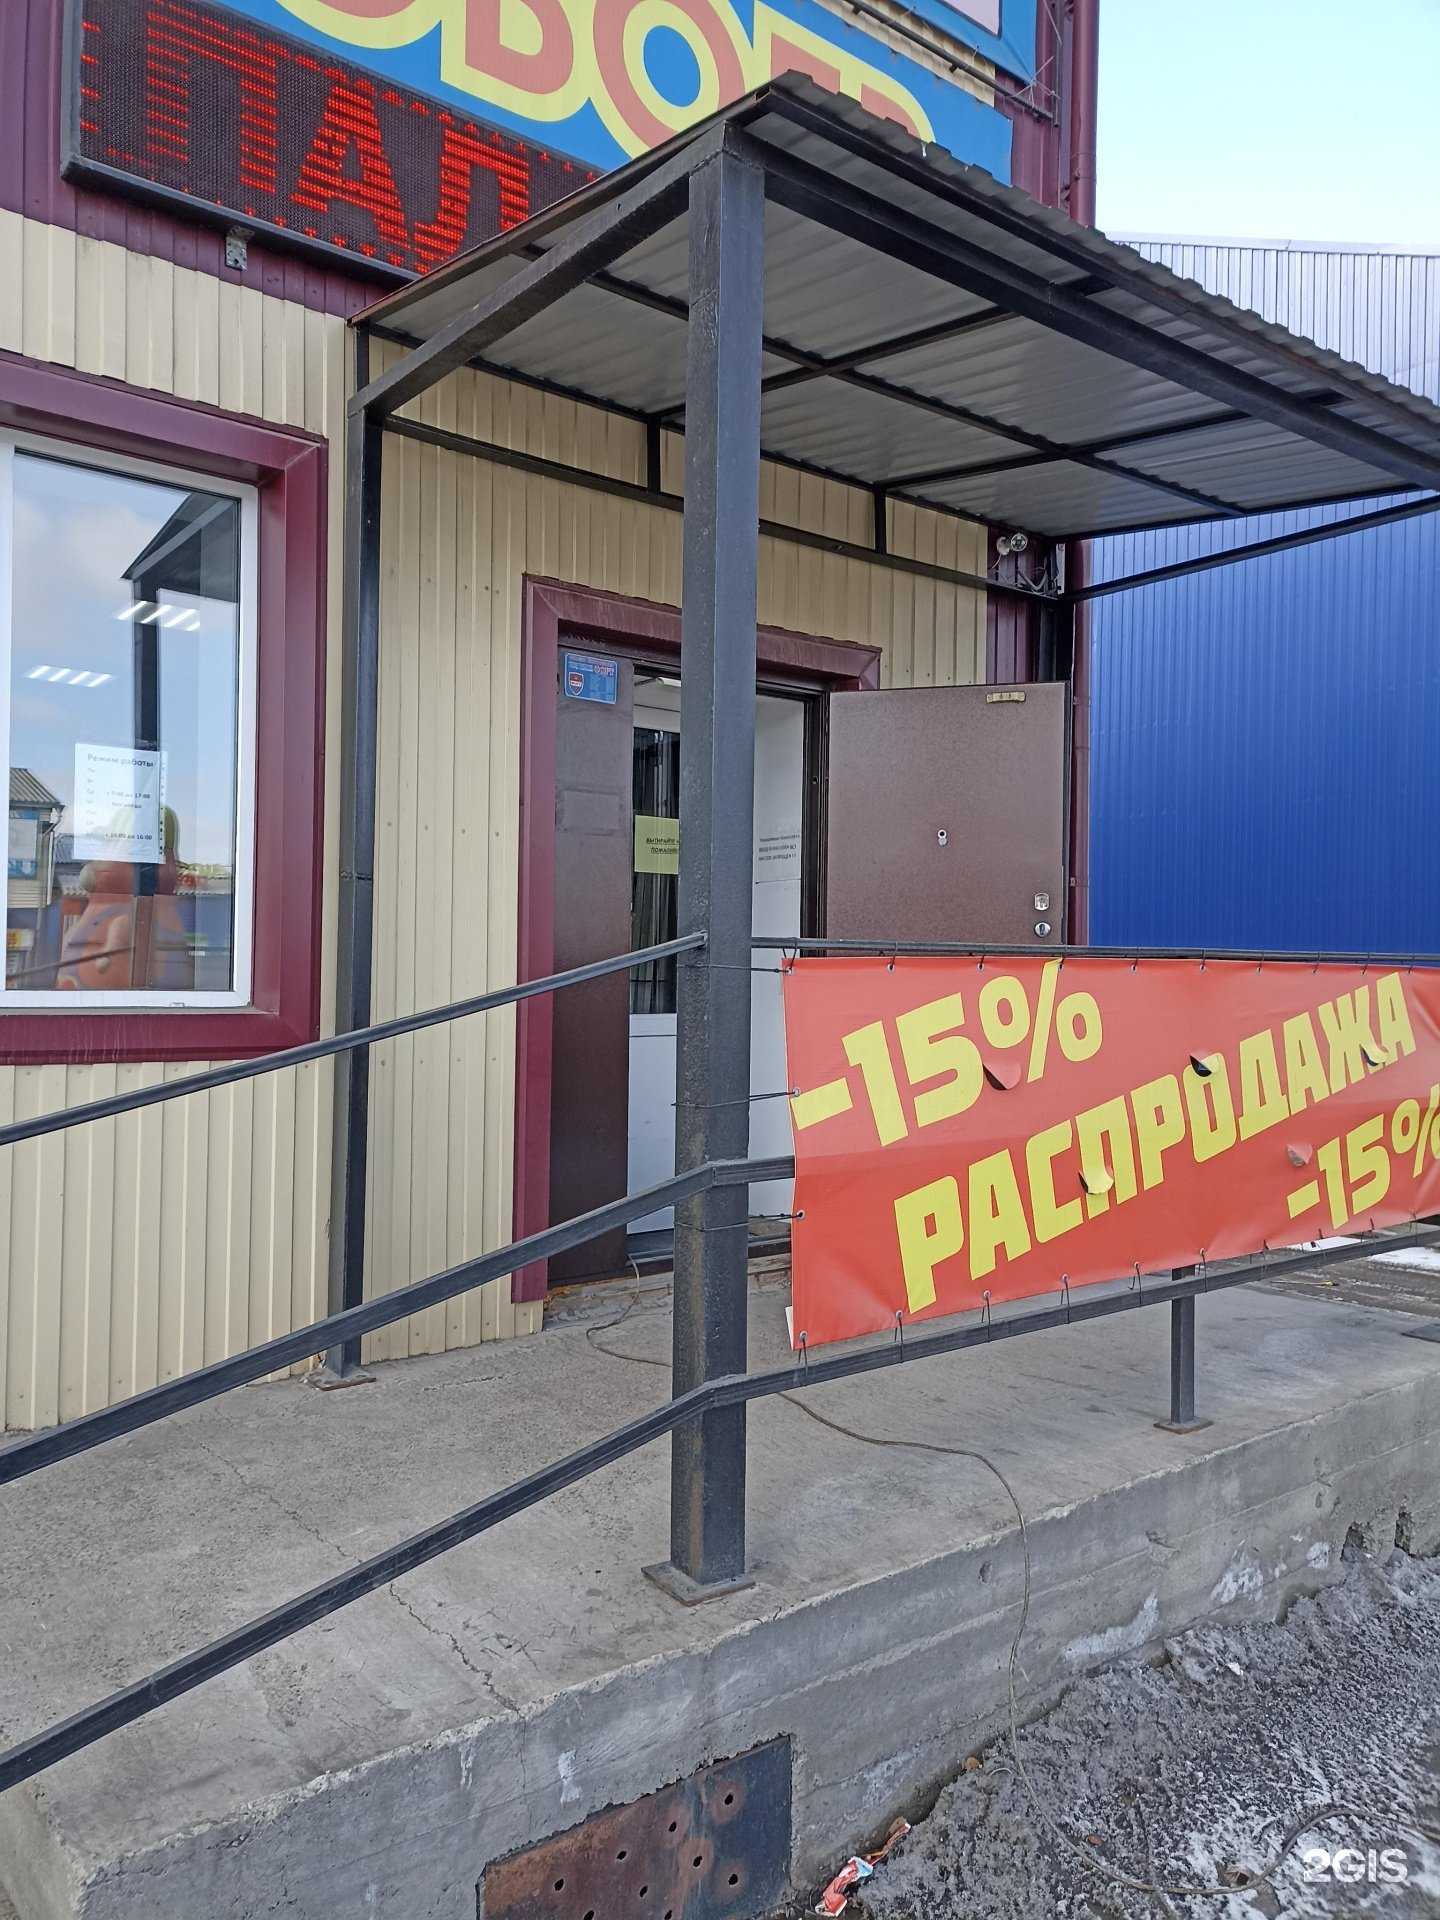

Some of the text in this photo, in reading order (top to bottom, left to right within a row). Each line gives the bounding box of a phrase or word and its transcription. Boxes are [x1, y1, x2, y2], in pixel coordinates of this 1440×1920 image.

[790, 957, 1103, 1147] -15%
[893, 971, 1417, 1314] РАСПРОДАЖА
[1286, 1083, 1440, 1230] -15%
